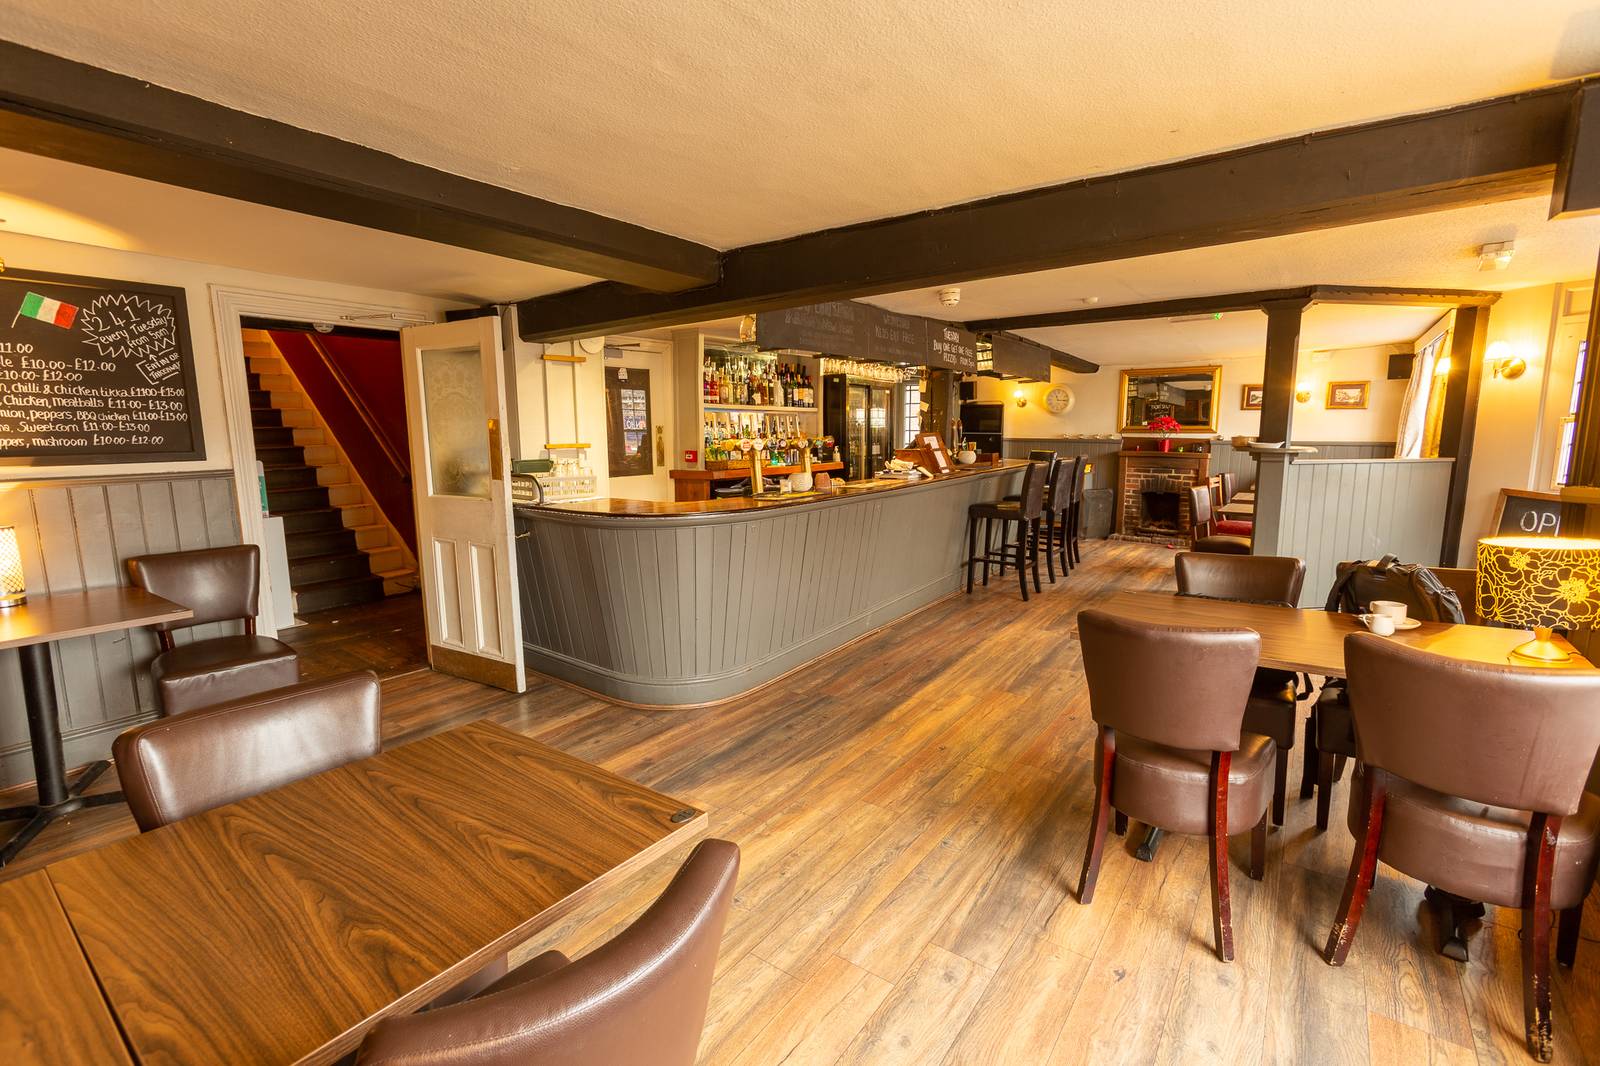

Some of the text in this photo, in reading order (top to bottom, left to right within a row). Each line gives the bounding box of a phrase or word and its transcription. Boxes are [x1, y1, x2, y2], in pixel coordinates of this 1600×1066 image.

[100, 316, 168, 344] every Tuesday
[43, 384, 54, 395] &
[100, 387, 131, 397] tikka
[76, 410, 97, 421] BBQ
